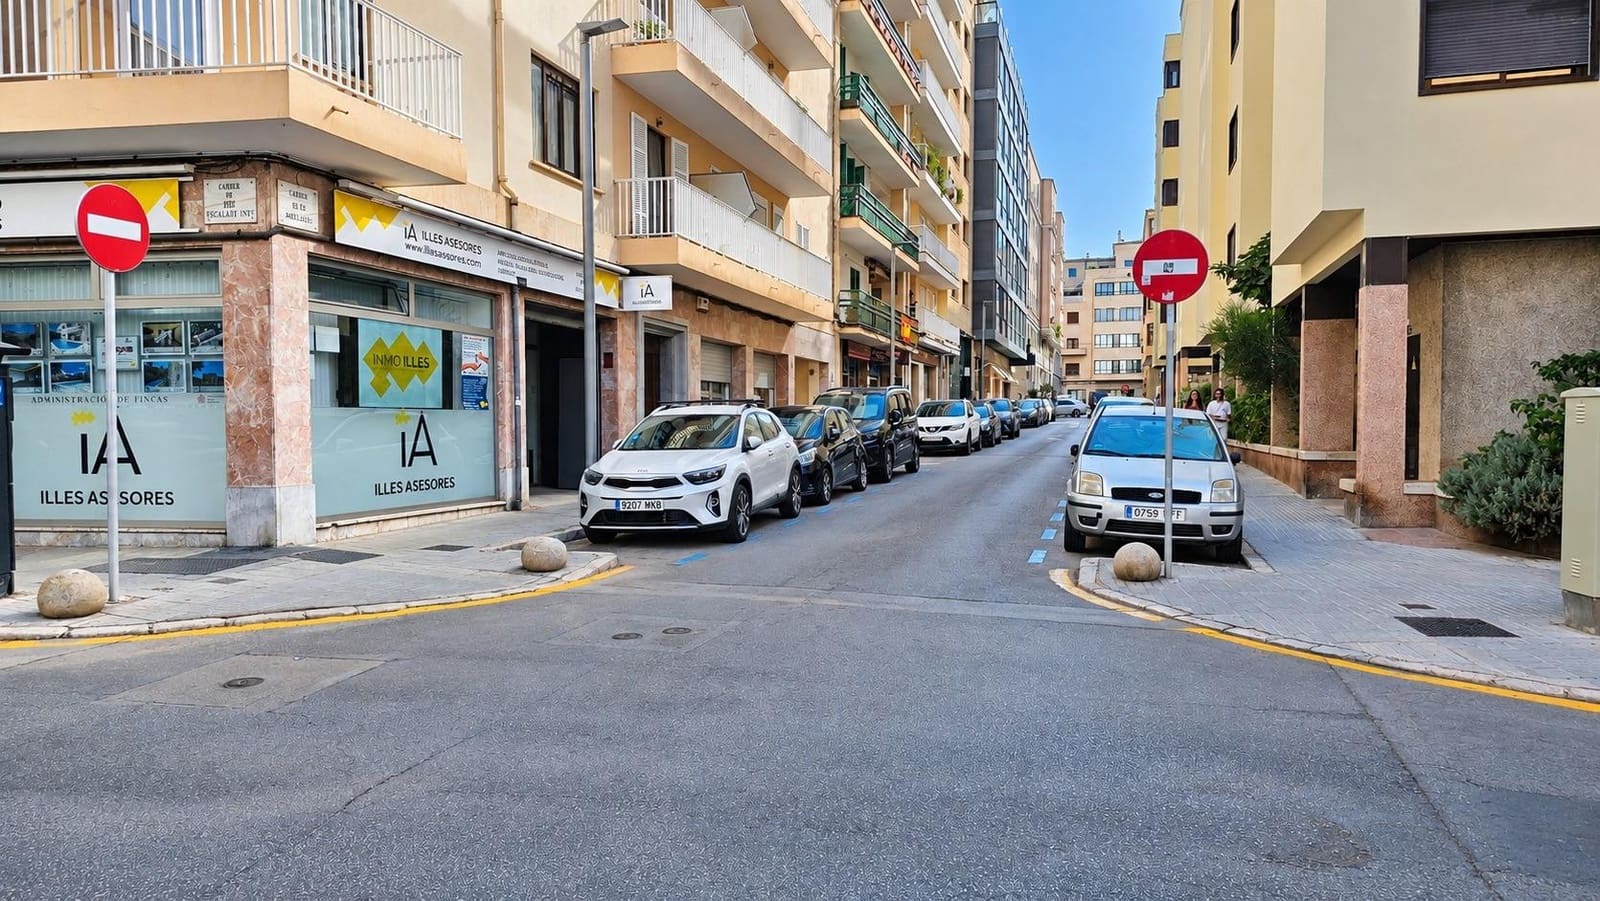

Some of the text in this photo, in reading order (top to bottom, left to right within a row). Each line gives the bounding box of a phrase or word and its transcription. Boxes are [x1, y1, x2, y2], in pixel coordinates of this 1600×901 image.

[421, 230, 443, 245] ILLES
[443, 236, 482, 256] ASESORES
[373, 354, 430, 368] INMO ILLES
[31, 395, 109, 404] ADMINISTRACIÓ
[134, 395, 168, 403] FINCAS
[374, 477, 455, 496] ILLES ASESORES
[40, 490, 175, 506] ILLES ASSORES
[621, 501, 641, 509] 9207
[1134, 508, 1159, 518] 0759
